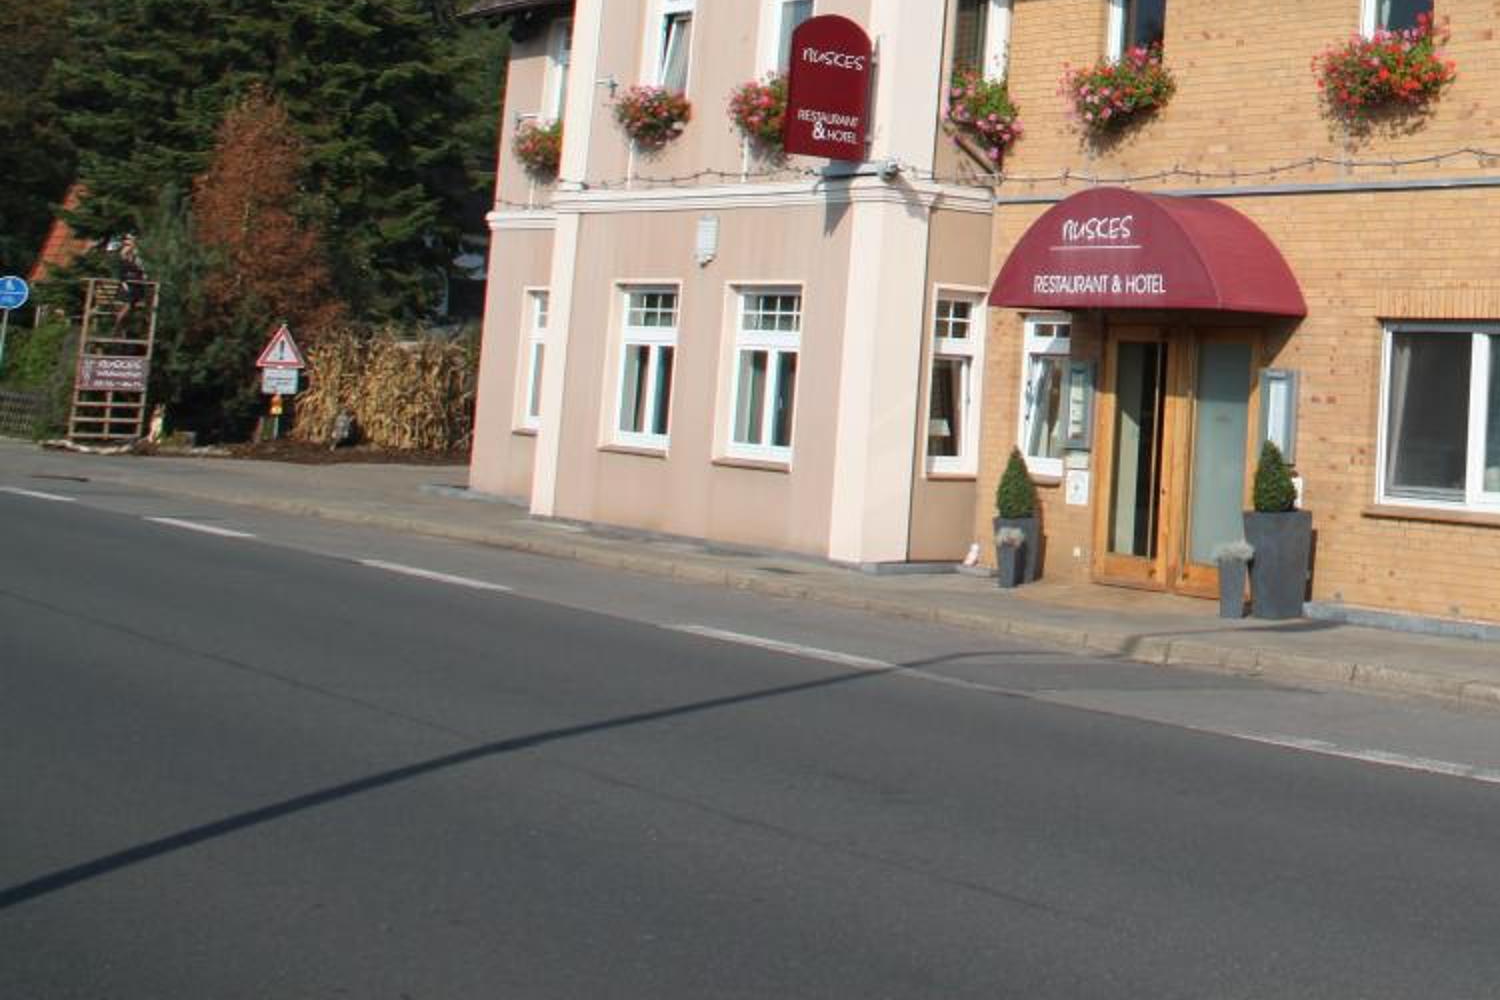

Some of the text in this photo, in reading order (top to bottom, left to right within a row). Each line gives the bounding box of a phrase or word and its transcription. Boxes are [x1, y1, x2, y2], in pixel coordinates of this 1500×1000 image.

[798, 109, 859, 127] RESTAURANT
[813, 121, 858, 145] & HOTEL
[1033, 274, 1167, 294] RESTAURANT & HOTEL
